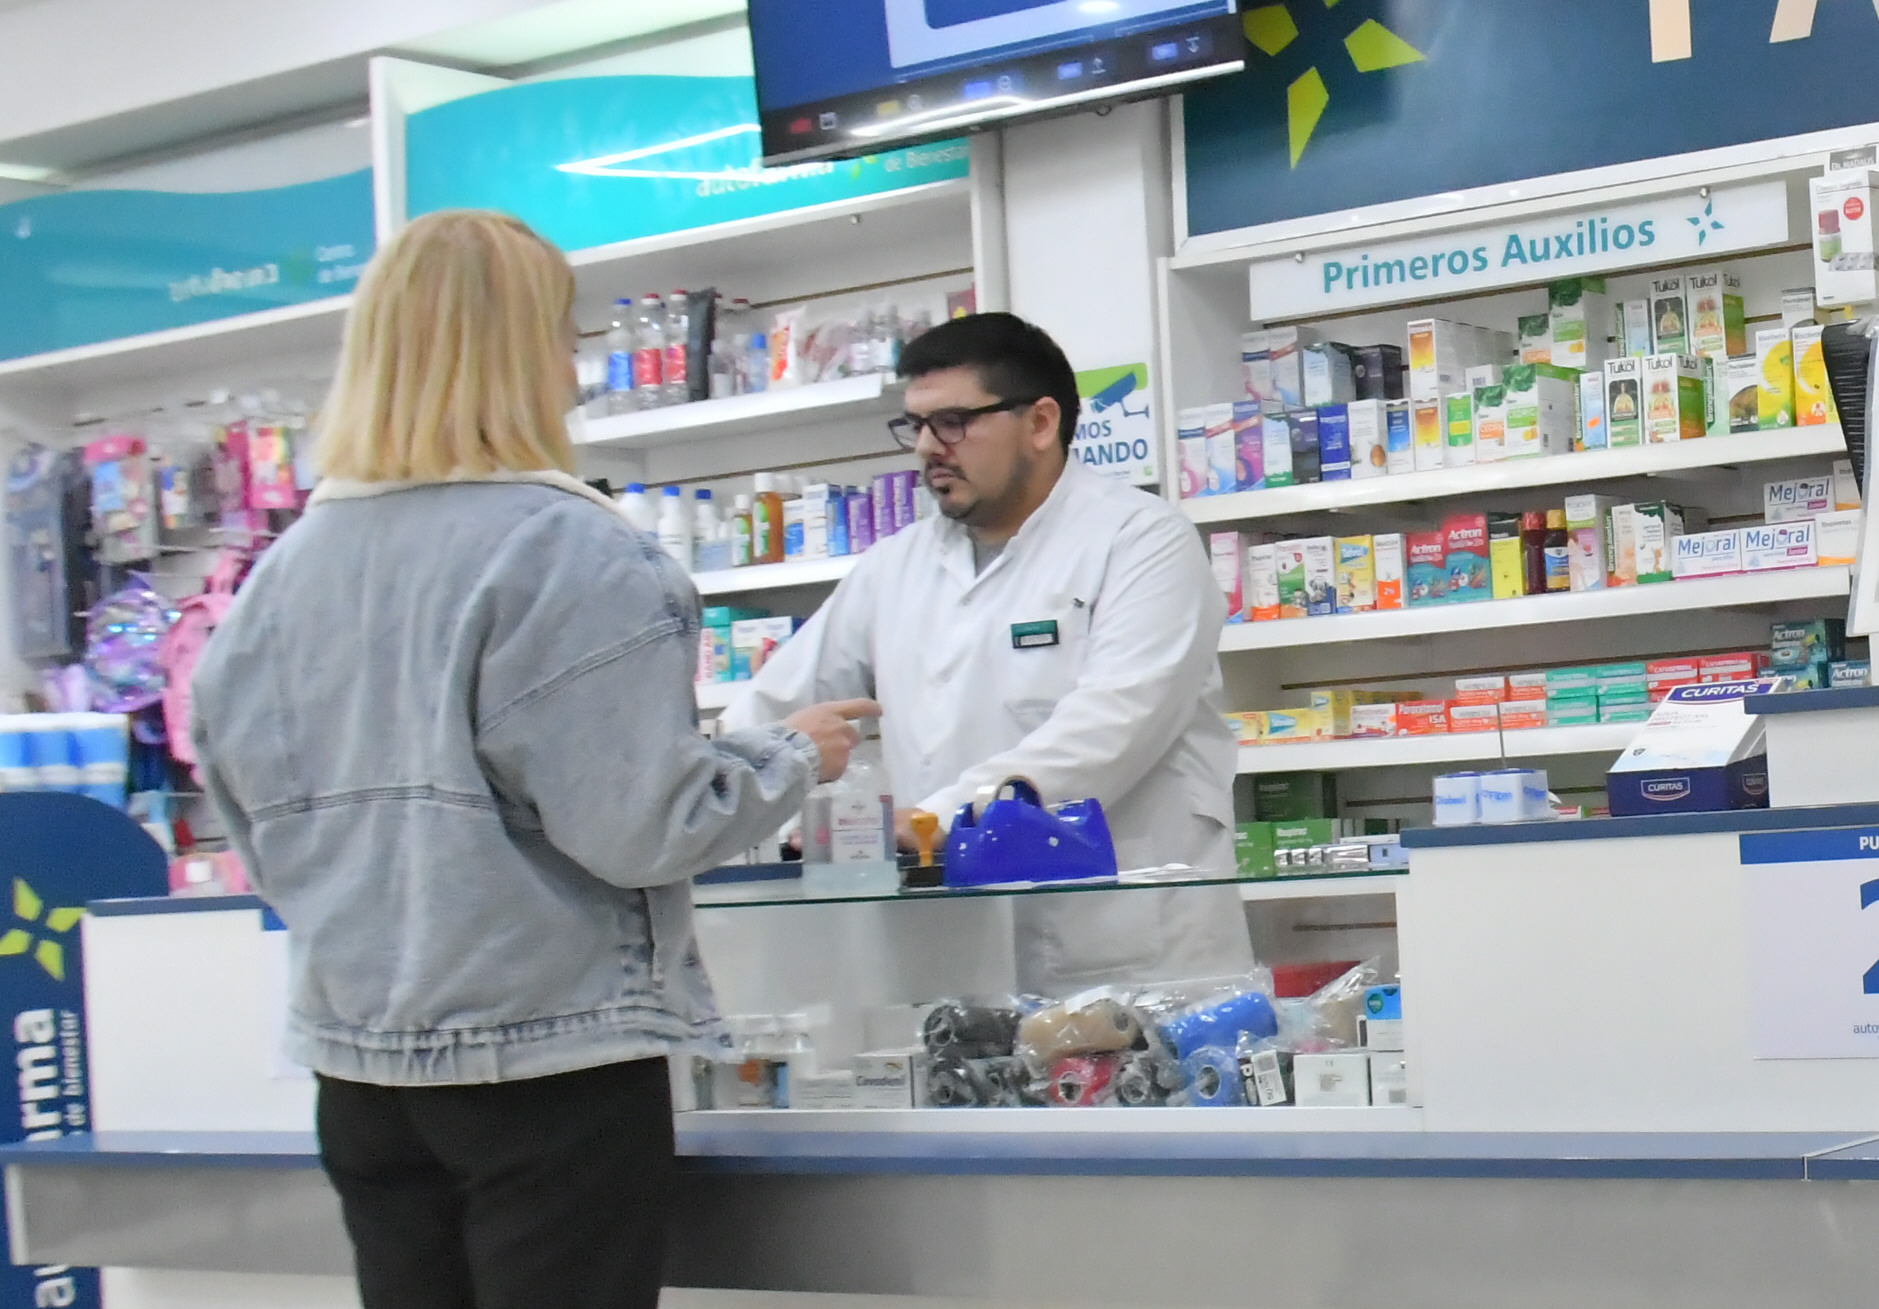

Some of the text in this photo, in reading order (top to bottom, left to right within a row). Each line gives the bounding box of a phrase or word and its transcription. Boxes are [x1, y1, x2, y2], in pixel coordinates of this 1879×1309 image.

[1323, 216, 1656, 293] Primeros Auxilios
[1689, 275, 1717, 290] Tukol
[1607, 361, 1635, 374] Tukol
[1645, 358, 1673, 371] Tukol
[1072, 438, 1148, 466] ANDO
[1769, 478, 1830, 505] Mejoral
[1448, 528, 1482, 540] Actron
[1745, 525, 1810, 550] Mejoral
[1410, 544, 1442, 555] Actron
[1678, 533, 1736, 557] Mejoral
[1772, 629, 1805, 641] Actron
[1831, 667, 1868, 679] Actron
[1681, 684, 1759, 698] CURITAS
[1647, 782, 1684, 792] CURITAS
[1853, 1022, 1879, 1037] auto
[59, 1009, 83, 1096] bienestar
